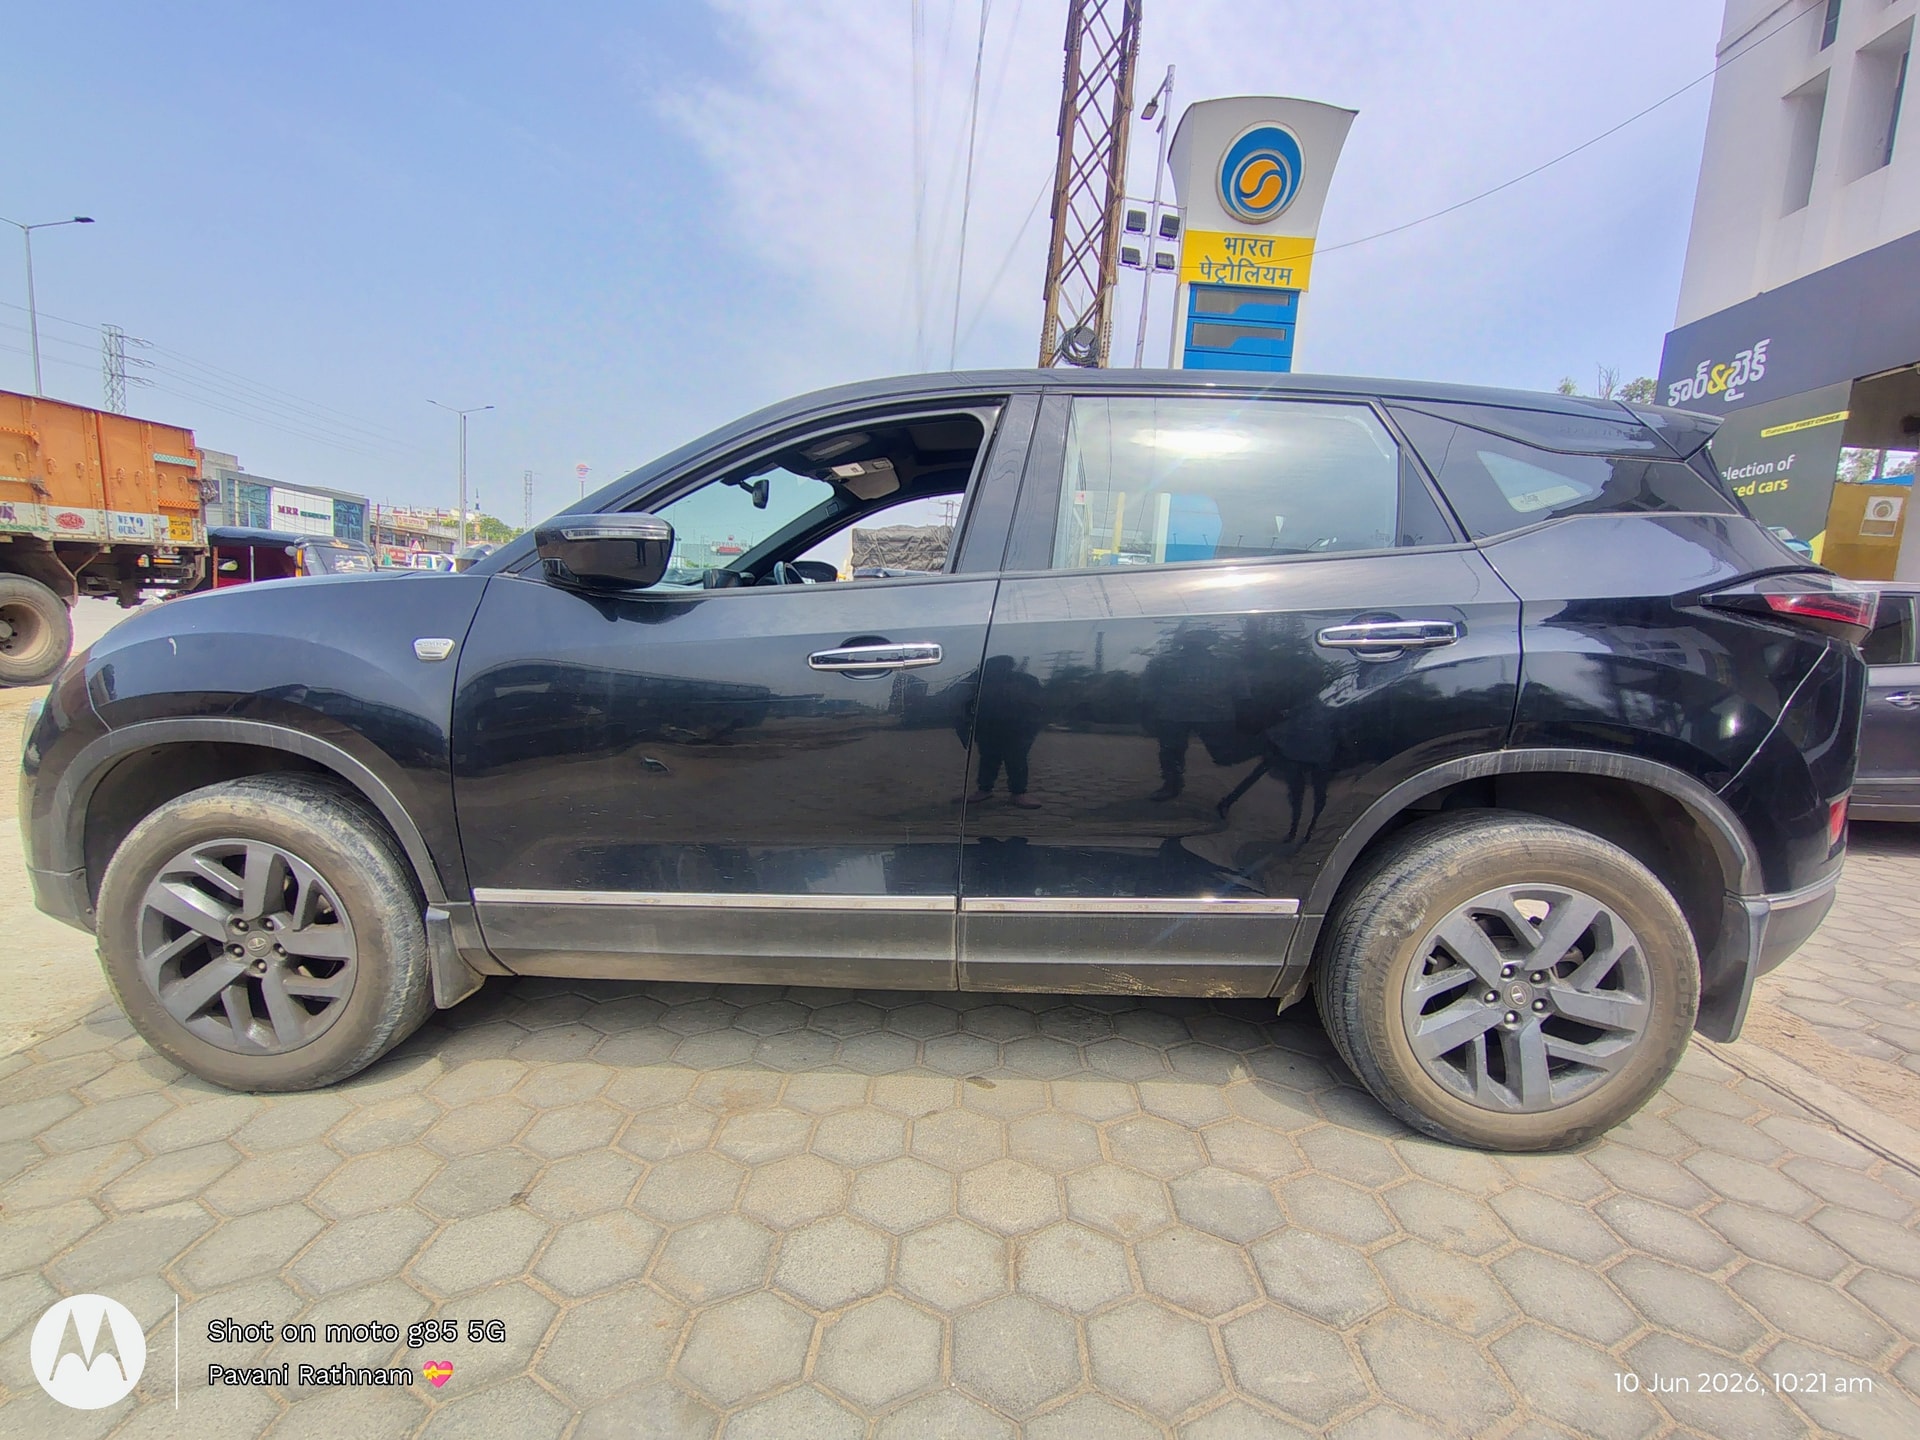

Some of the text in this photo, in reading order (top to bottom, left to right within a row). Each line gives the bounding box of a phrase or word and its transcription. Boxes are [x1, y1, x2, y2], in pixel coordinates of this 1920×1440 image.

[1223, 236, 1276, 258] भारत
[1198, 255, 1293, 285] पेट्रोलियम
[1777, 453, 1797, 471] of
[1758, 479, 1789, 494] cars
[277, 504, 299, 516] MRR
